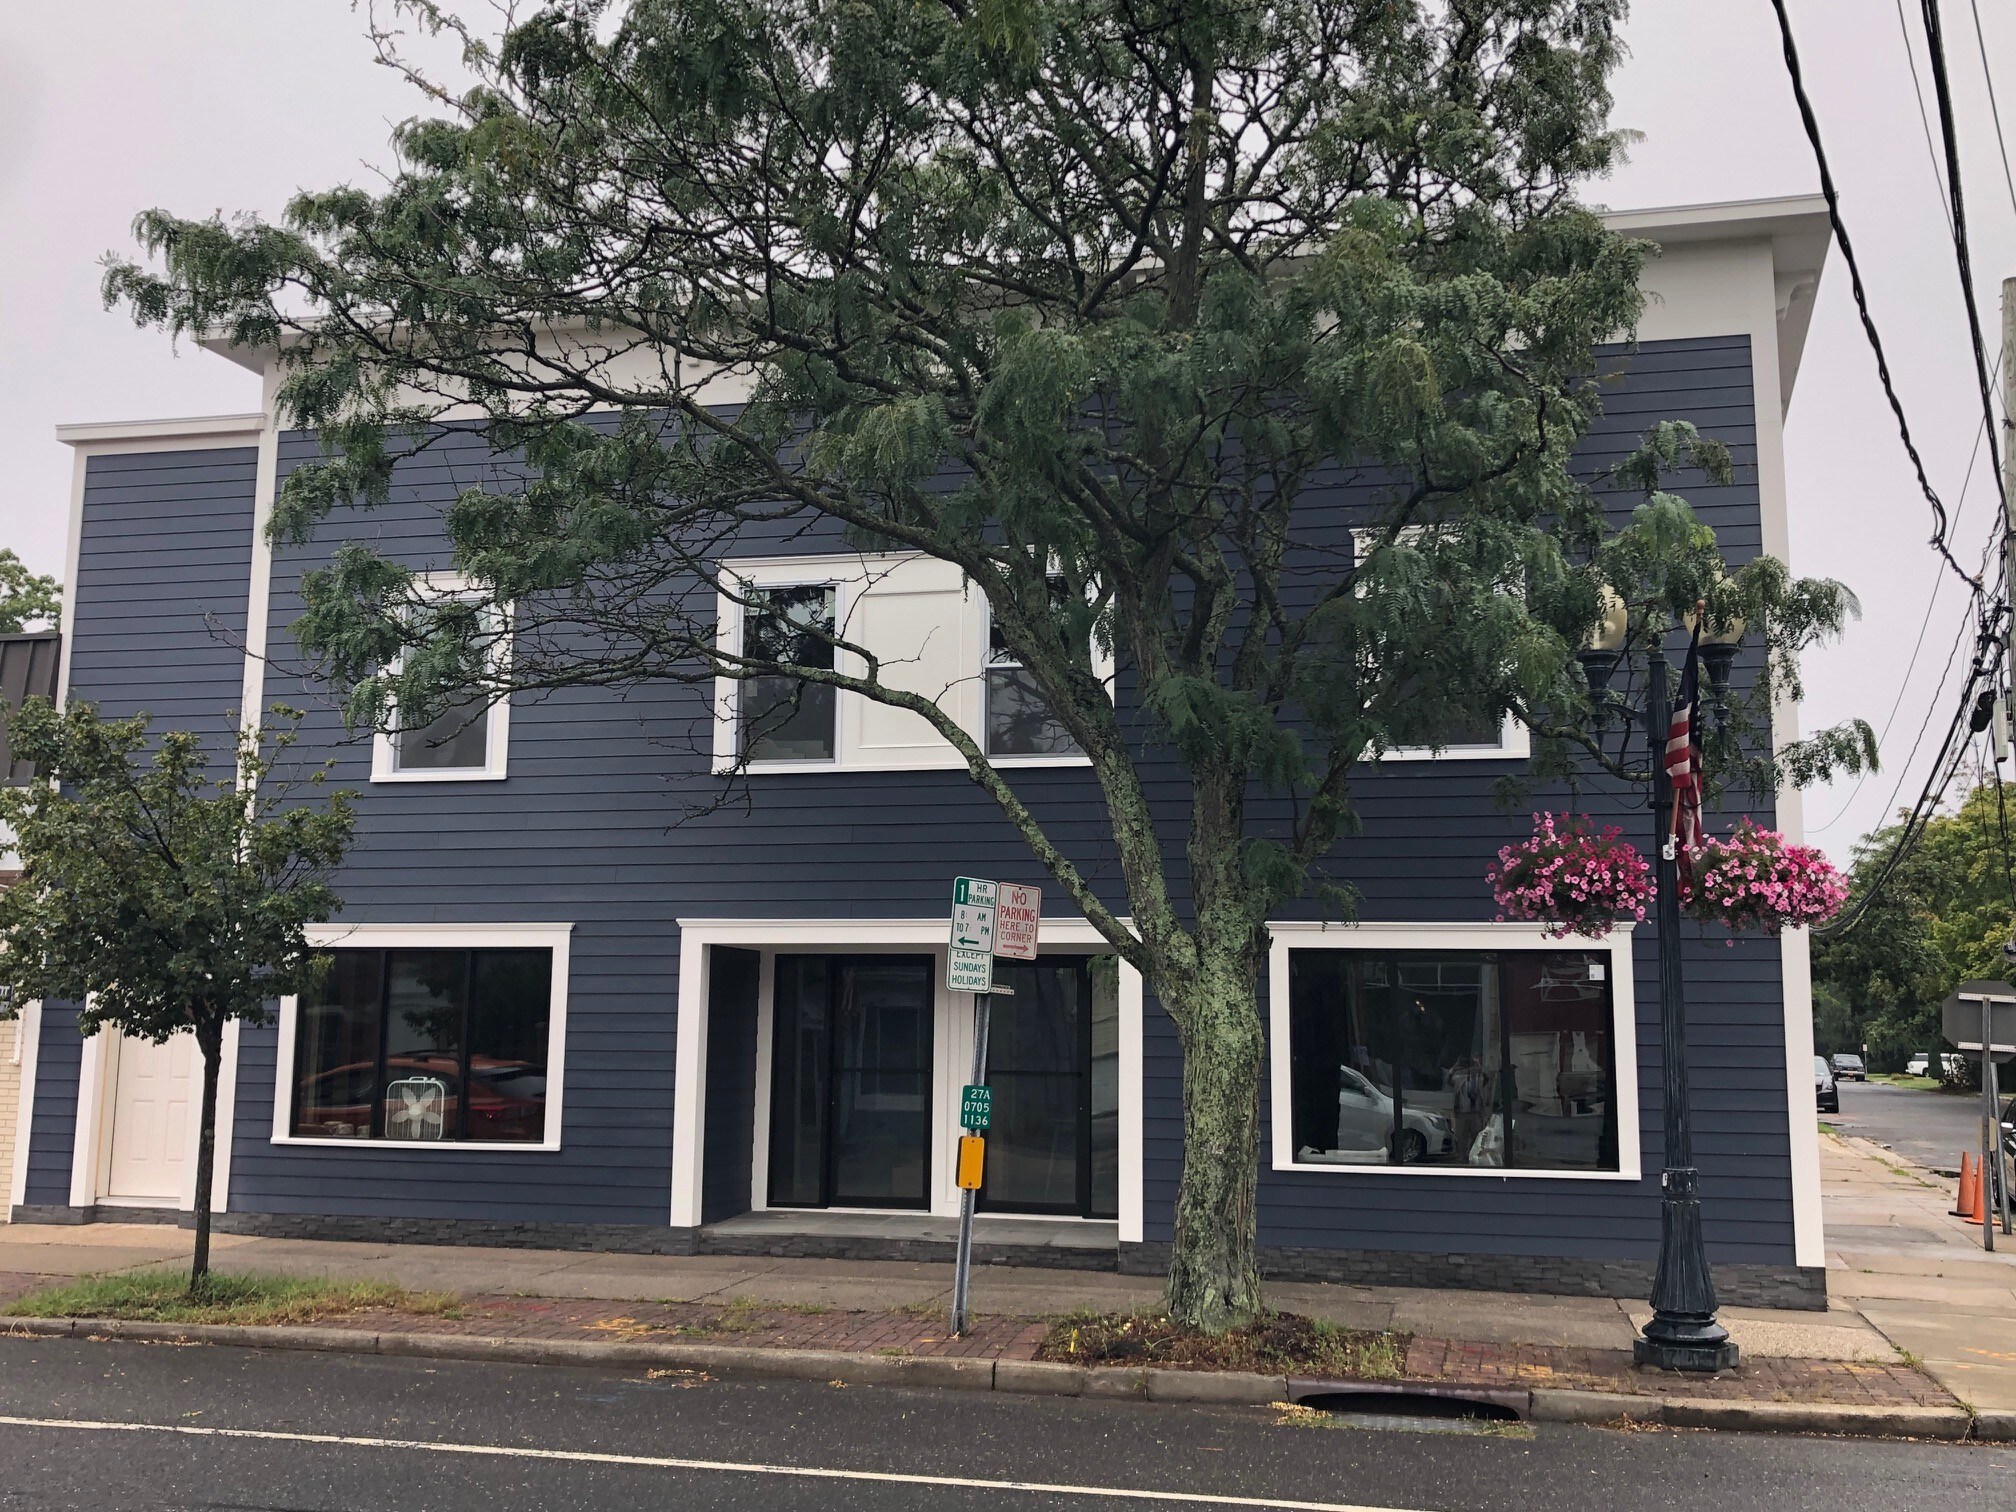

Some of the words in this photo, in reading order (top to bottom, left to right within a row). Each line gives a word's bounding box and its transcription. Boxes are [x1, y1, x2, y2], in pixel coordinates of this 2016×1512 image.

[960, 884, 965, 902] 1
[976, 884, 988, 894] HR
[968, 893, 995, 907] PARKING
[1011, 890, 1027, 906] NO
[977, 912, 987, 922] AM
[1000, 905, 1036, 923] PARKING
[956, 922, 964, 933] TO
[980, 925, 990, 936] PM
[1000, 920, 1020, 932] HERE
[1025, 923, 1035, 934] TO
[1000, 931, 1032, 944] CORNER
[956, 950, 984, 960] EXCEPT
[953, 961, 987, 974] SUNDAYS
[951, 974, 987, 987] HOLIDAYS
[970, 1088, 991, 1100] 27A
[964, 1101, 990, 1113] 0705
[963, 1114, 989, 1126] 1136
